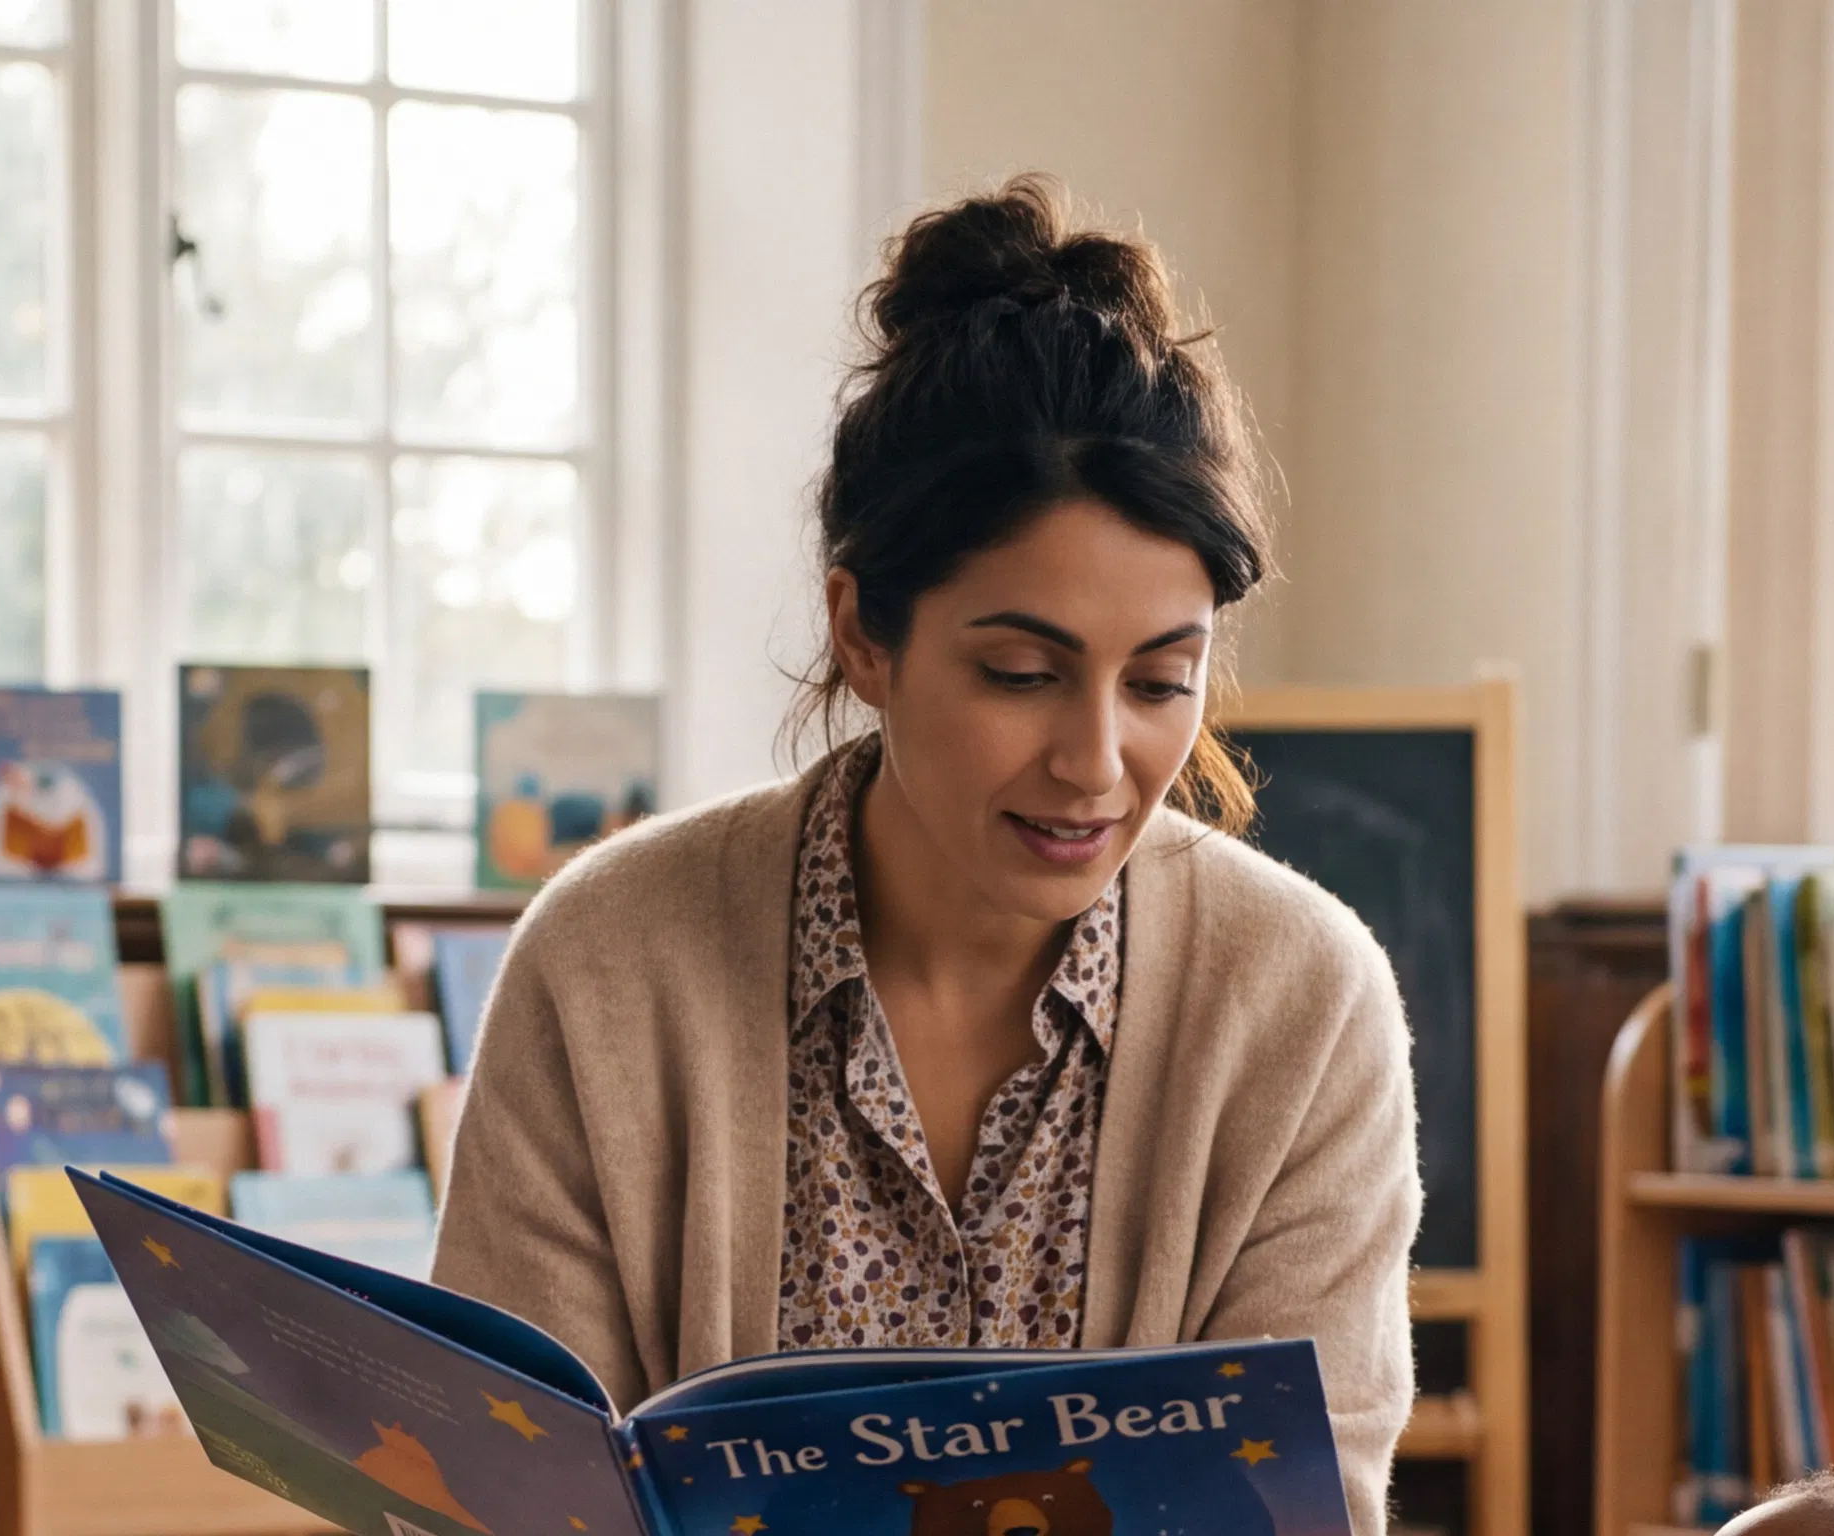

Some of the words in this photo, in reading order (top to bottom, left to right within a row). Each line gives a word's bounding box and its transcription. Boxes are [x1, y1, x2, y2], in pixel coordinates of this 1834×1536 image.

[706, 1437, 828, 1479] The
[850, 1412, 1025, 1465] Star
[1046, 1392, 1242, 1446] Bear
